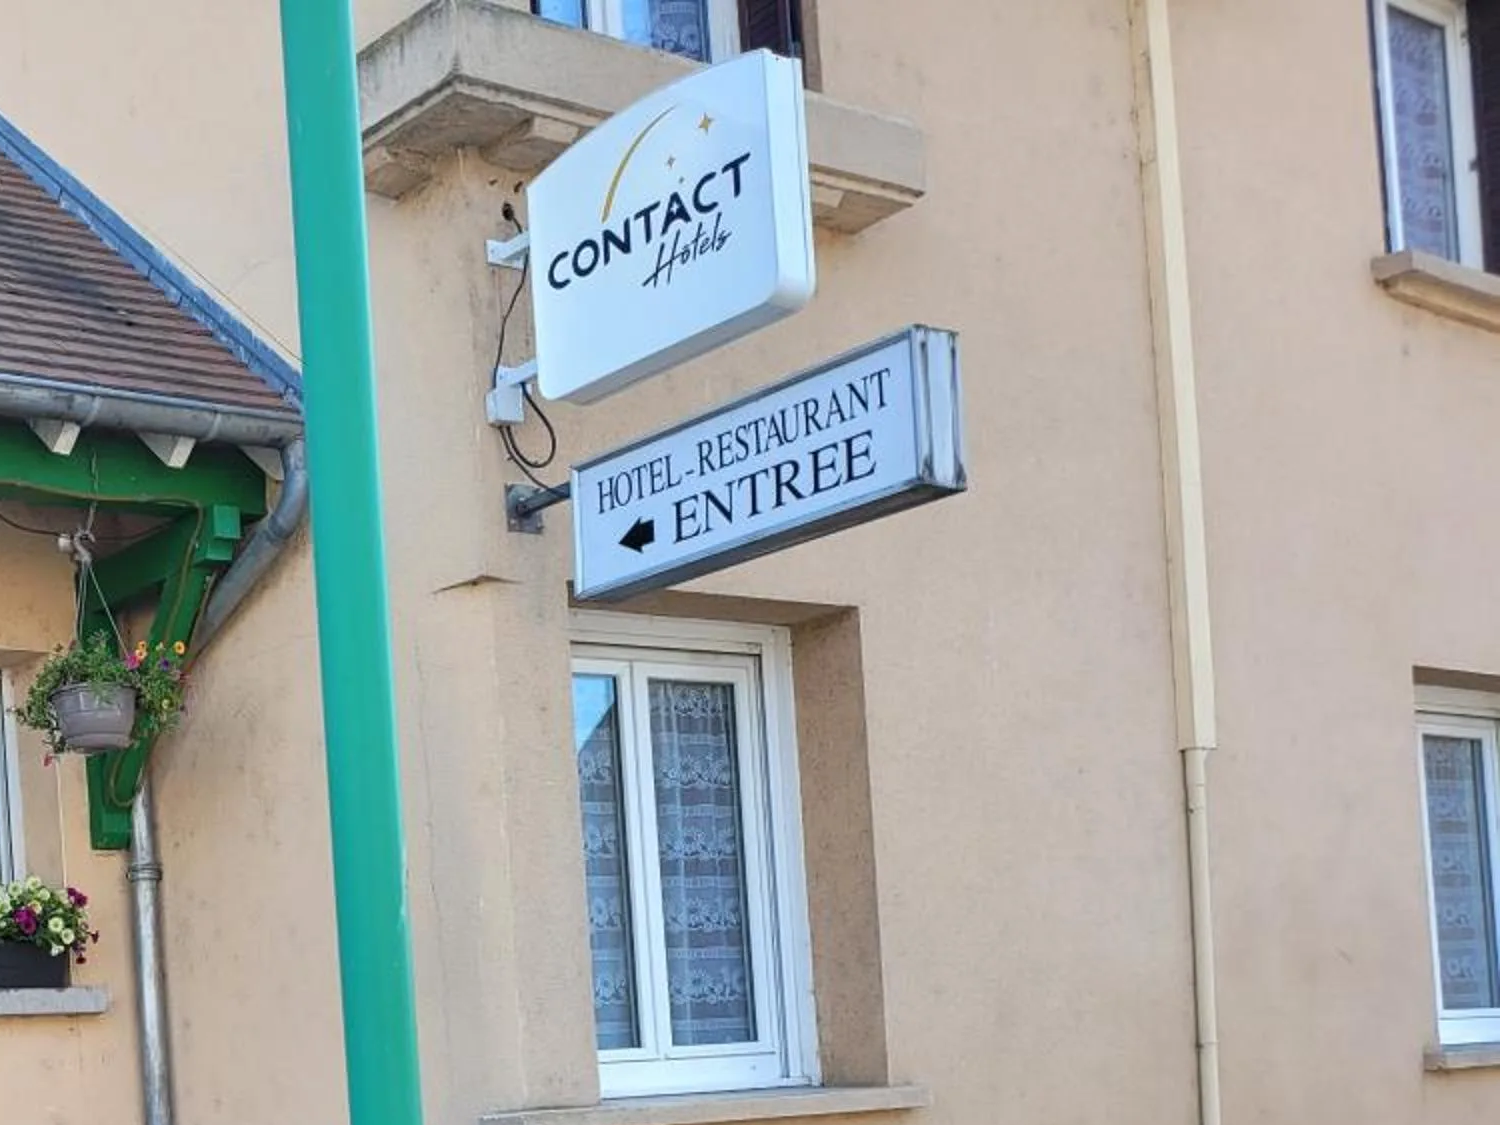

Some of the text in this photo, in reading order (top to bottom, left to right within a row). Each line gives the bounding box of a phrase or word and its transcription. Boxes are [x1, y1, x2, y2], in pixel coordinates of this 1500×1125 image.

[547, 153, 751, 290] CONTACT
[642, 211, 732, 288] Hotels
[671, 430, 878, 545] ENTREE
